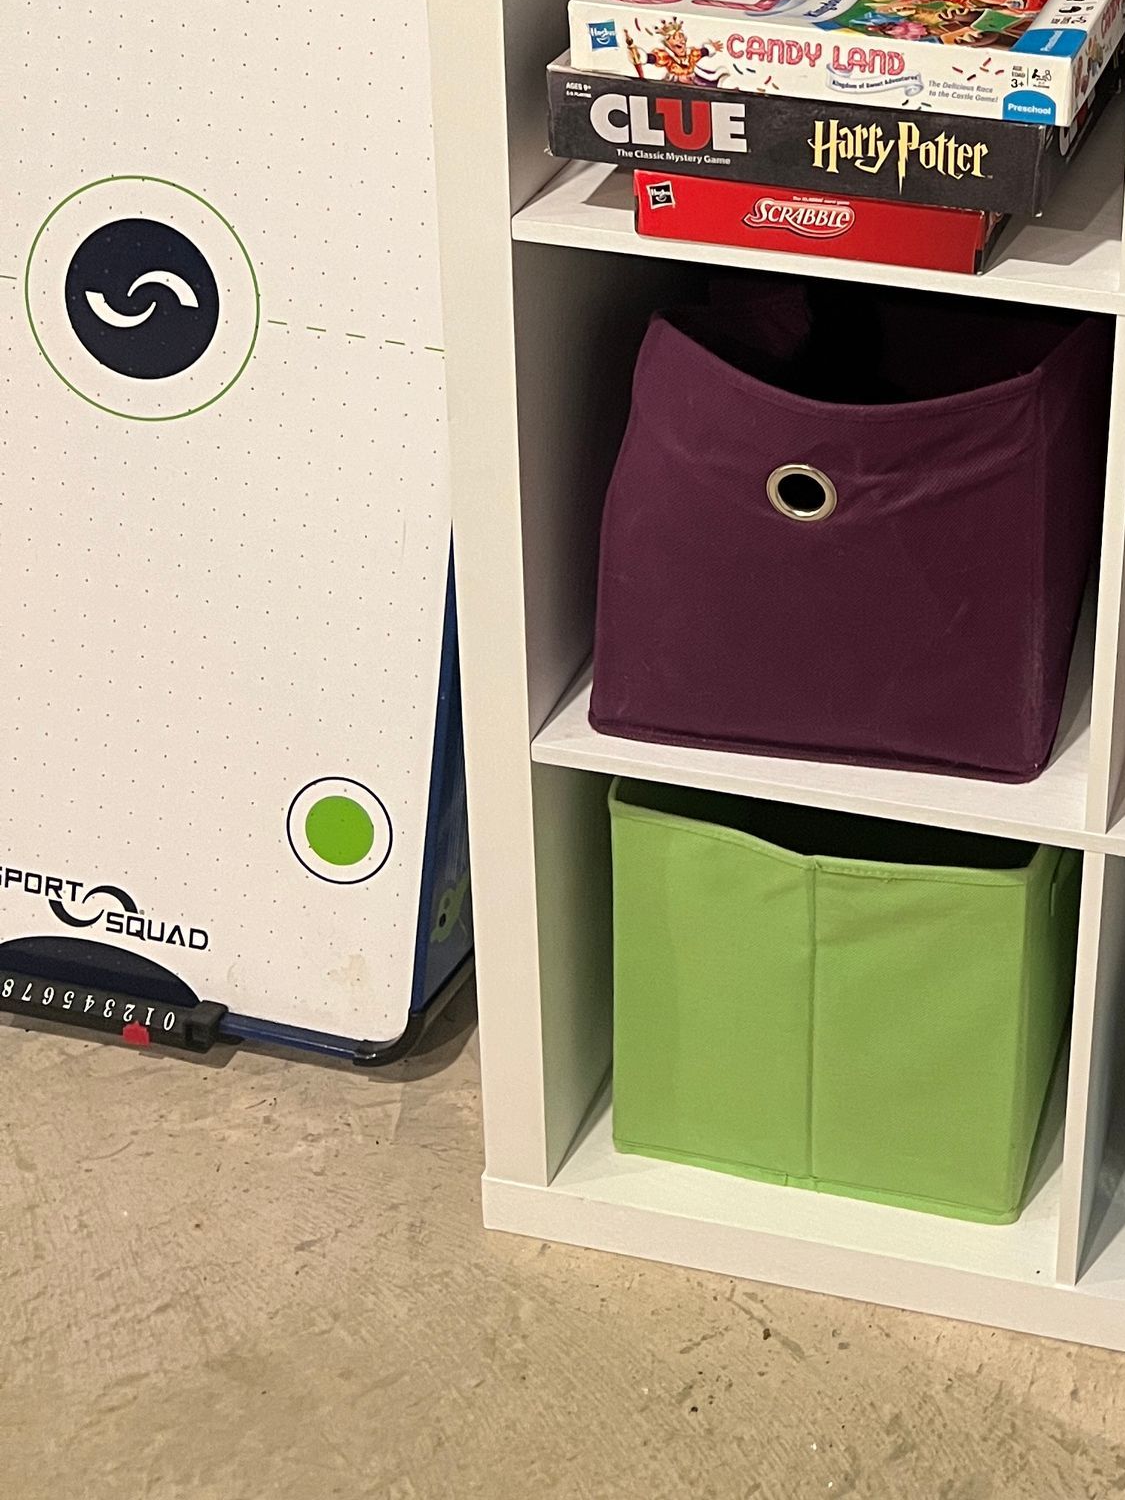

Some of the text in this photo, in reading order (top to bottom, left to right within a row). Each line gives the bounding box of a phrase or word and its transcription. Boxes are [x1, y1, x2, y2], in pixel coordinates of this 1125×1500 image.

[726, 32, 907, 76] CANDY LAND
[566, 82, 582, 91] AGES
[928, 80, 994, 94] The Delicious Race
[1010, 79, 1025, 89] 3+
[928, 89, 937, 97] to
[937, 90, 950, 99] the
[950, 91, 974, 101] Castle
[1007, 103, 1051, 116] Preschool
[589, 92, 749, 154] CLUE
[616, 148, 731, 166] The Classic Mystery Game
[806, 119, 900, 175] Harry
[896, 120, 991, 196] Potter
[0, 866, 84, 902] PORT
[105, 911, 210, 951] SQUAD
